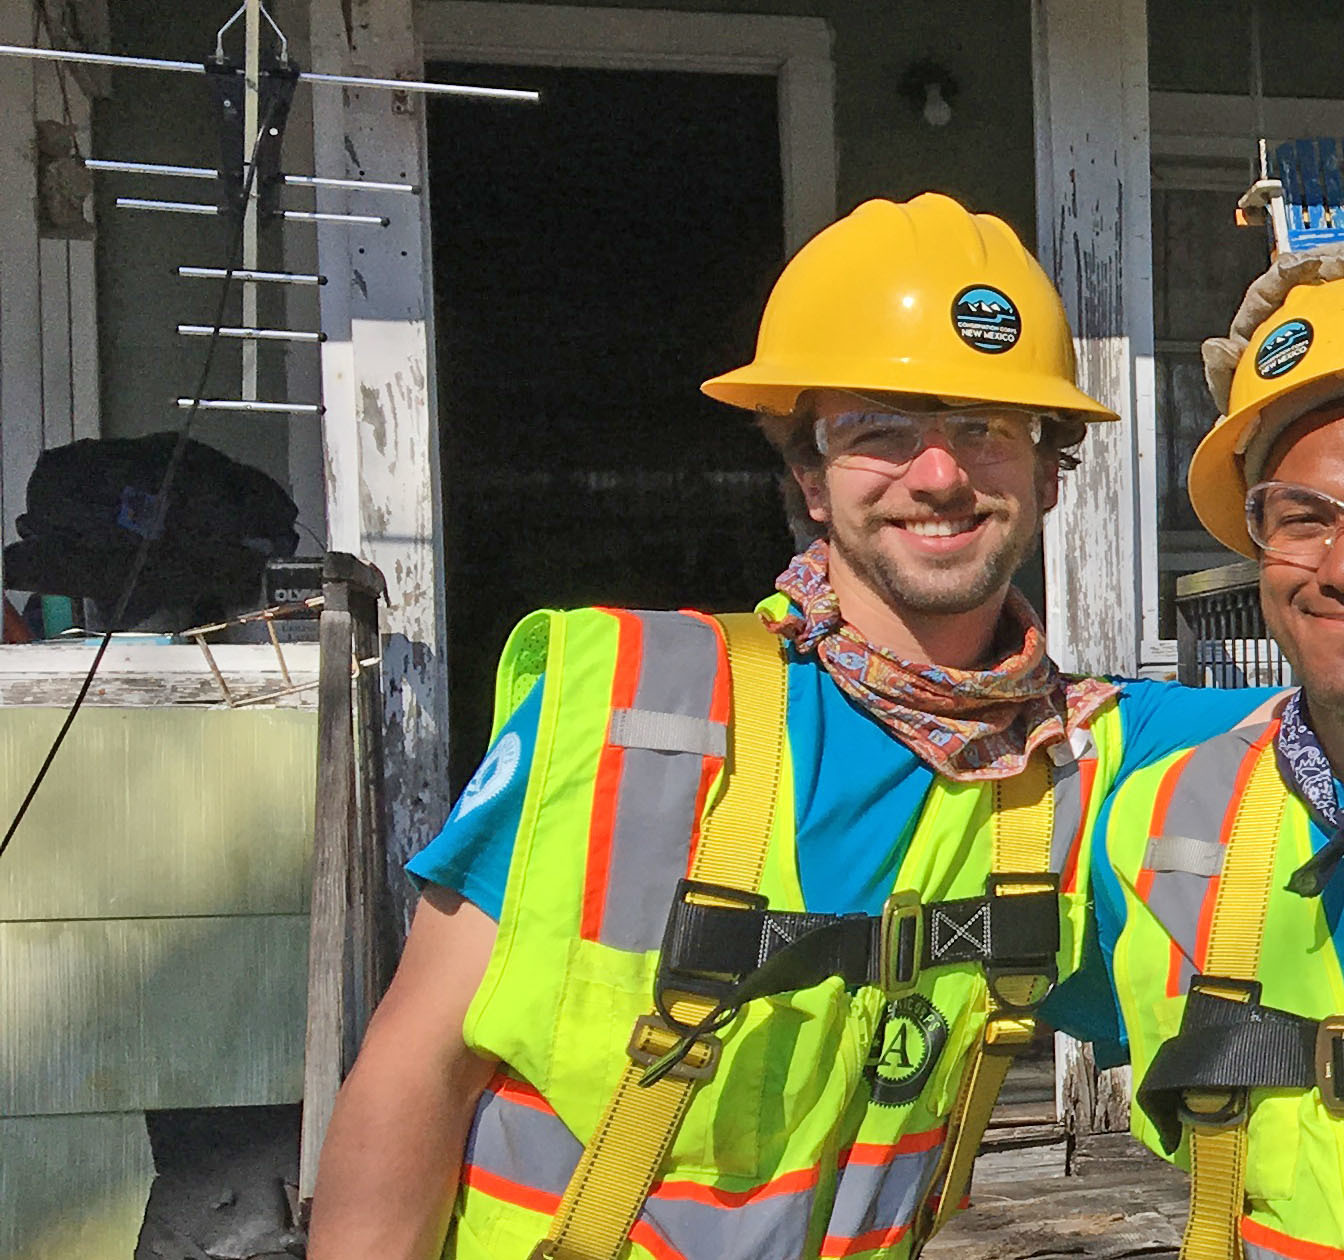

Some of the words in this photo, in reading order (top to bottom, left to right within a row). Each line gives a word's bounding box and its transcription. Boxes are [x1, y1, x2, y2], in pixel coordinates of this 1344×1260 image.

[961, 328, 983, 338] NEW
[983, 331, 1015, 343] MEXICO
[878, 1021, 914, 1069] A
